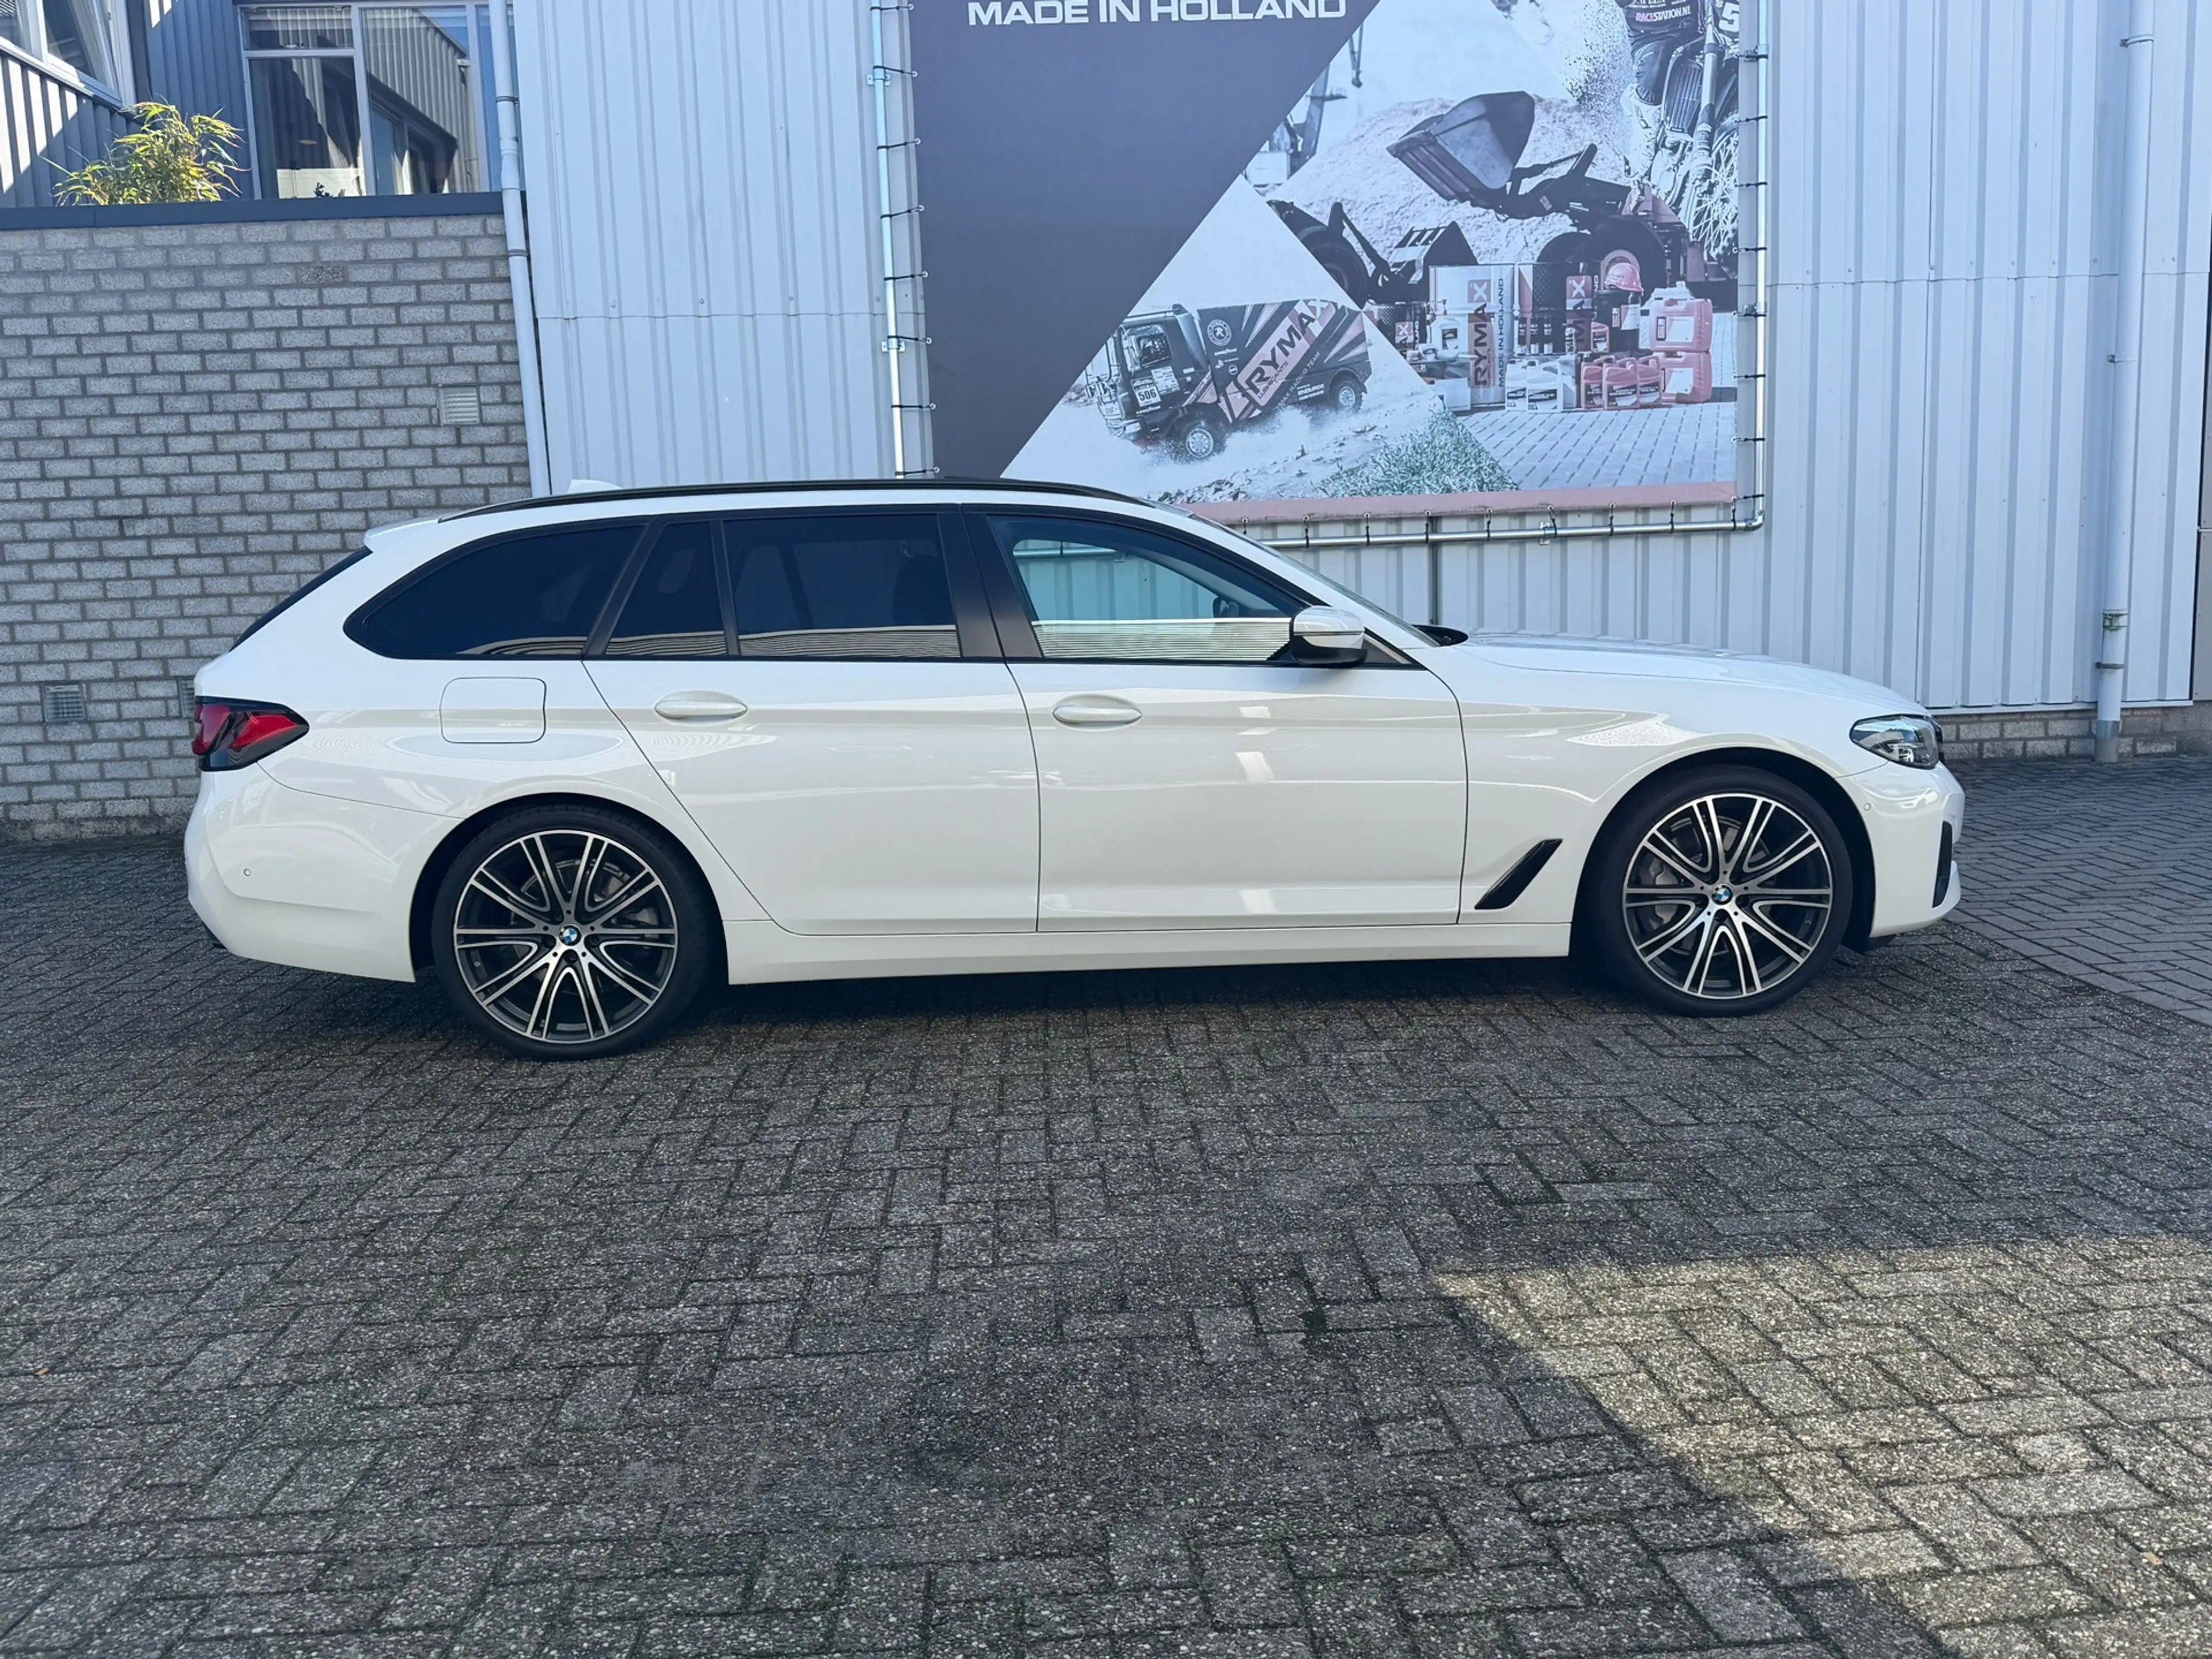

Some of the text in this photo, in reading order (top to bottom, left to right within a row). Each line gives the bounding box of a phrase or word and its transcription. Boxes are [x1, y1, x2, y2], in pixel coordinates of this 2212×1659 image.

[968, 0, 1346, 25] MADE IN HOLLAND
[1474, 281, 1488, 386] RYMAX
[1499, 338, 1504, 350] IN
[1138, 388, 1157, 402] 506
